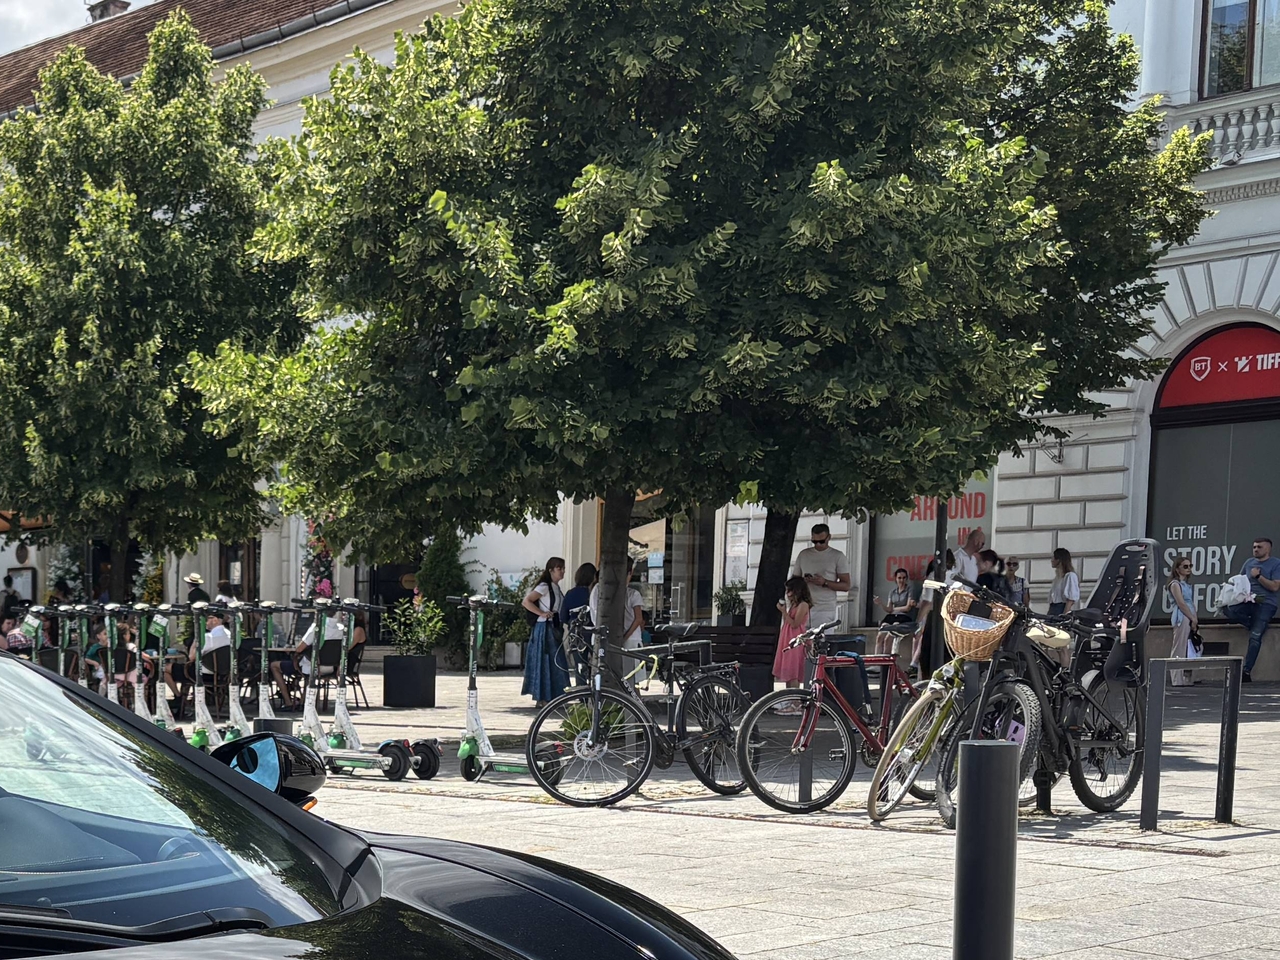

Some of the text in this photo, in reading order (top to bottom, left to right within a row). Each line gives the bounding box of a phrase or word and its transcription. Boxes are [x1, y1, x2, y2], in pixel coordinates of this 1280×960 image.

[1195, 361, 1207, 371] BT
[910, 492, 986, 521] ARUND
[1167, 525, 1207, 540] LET THE
